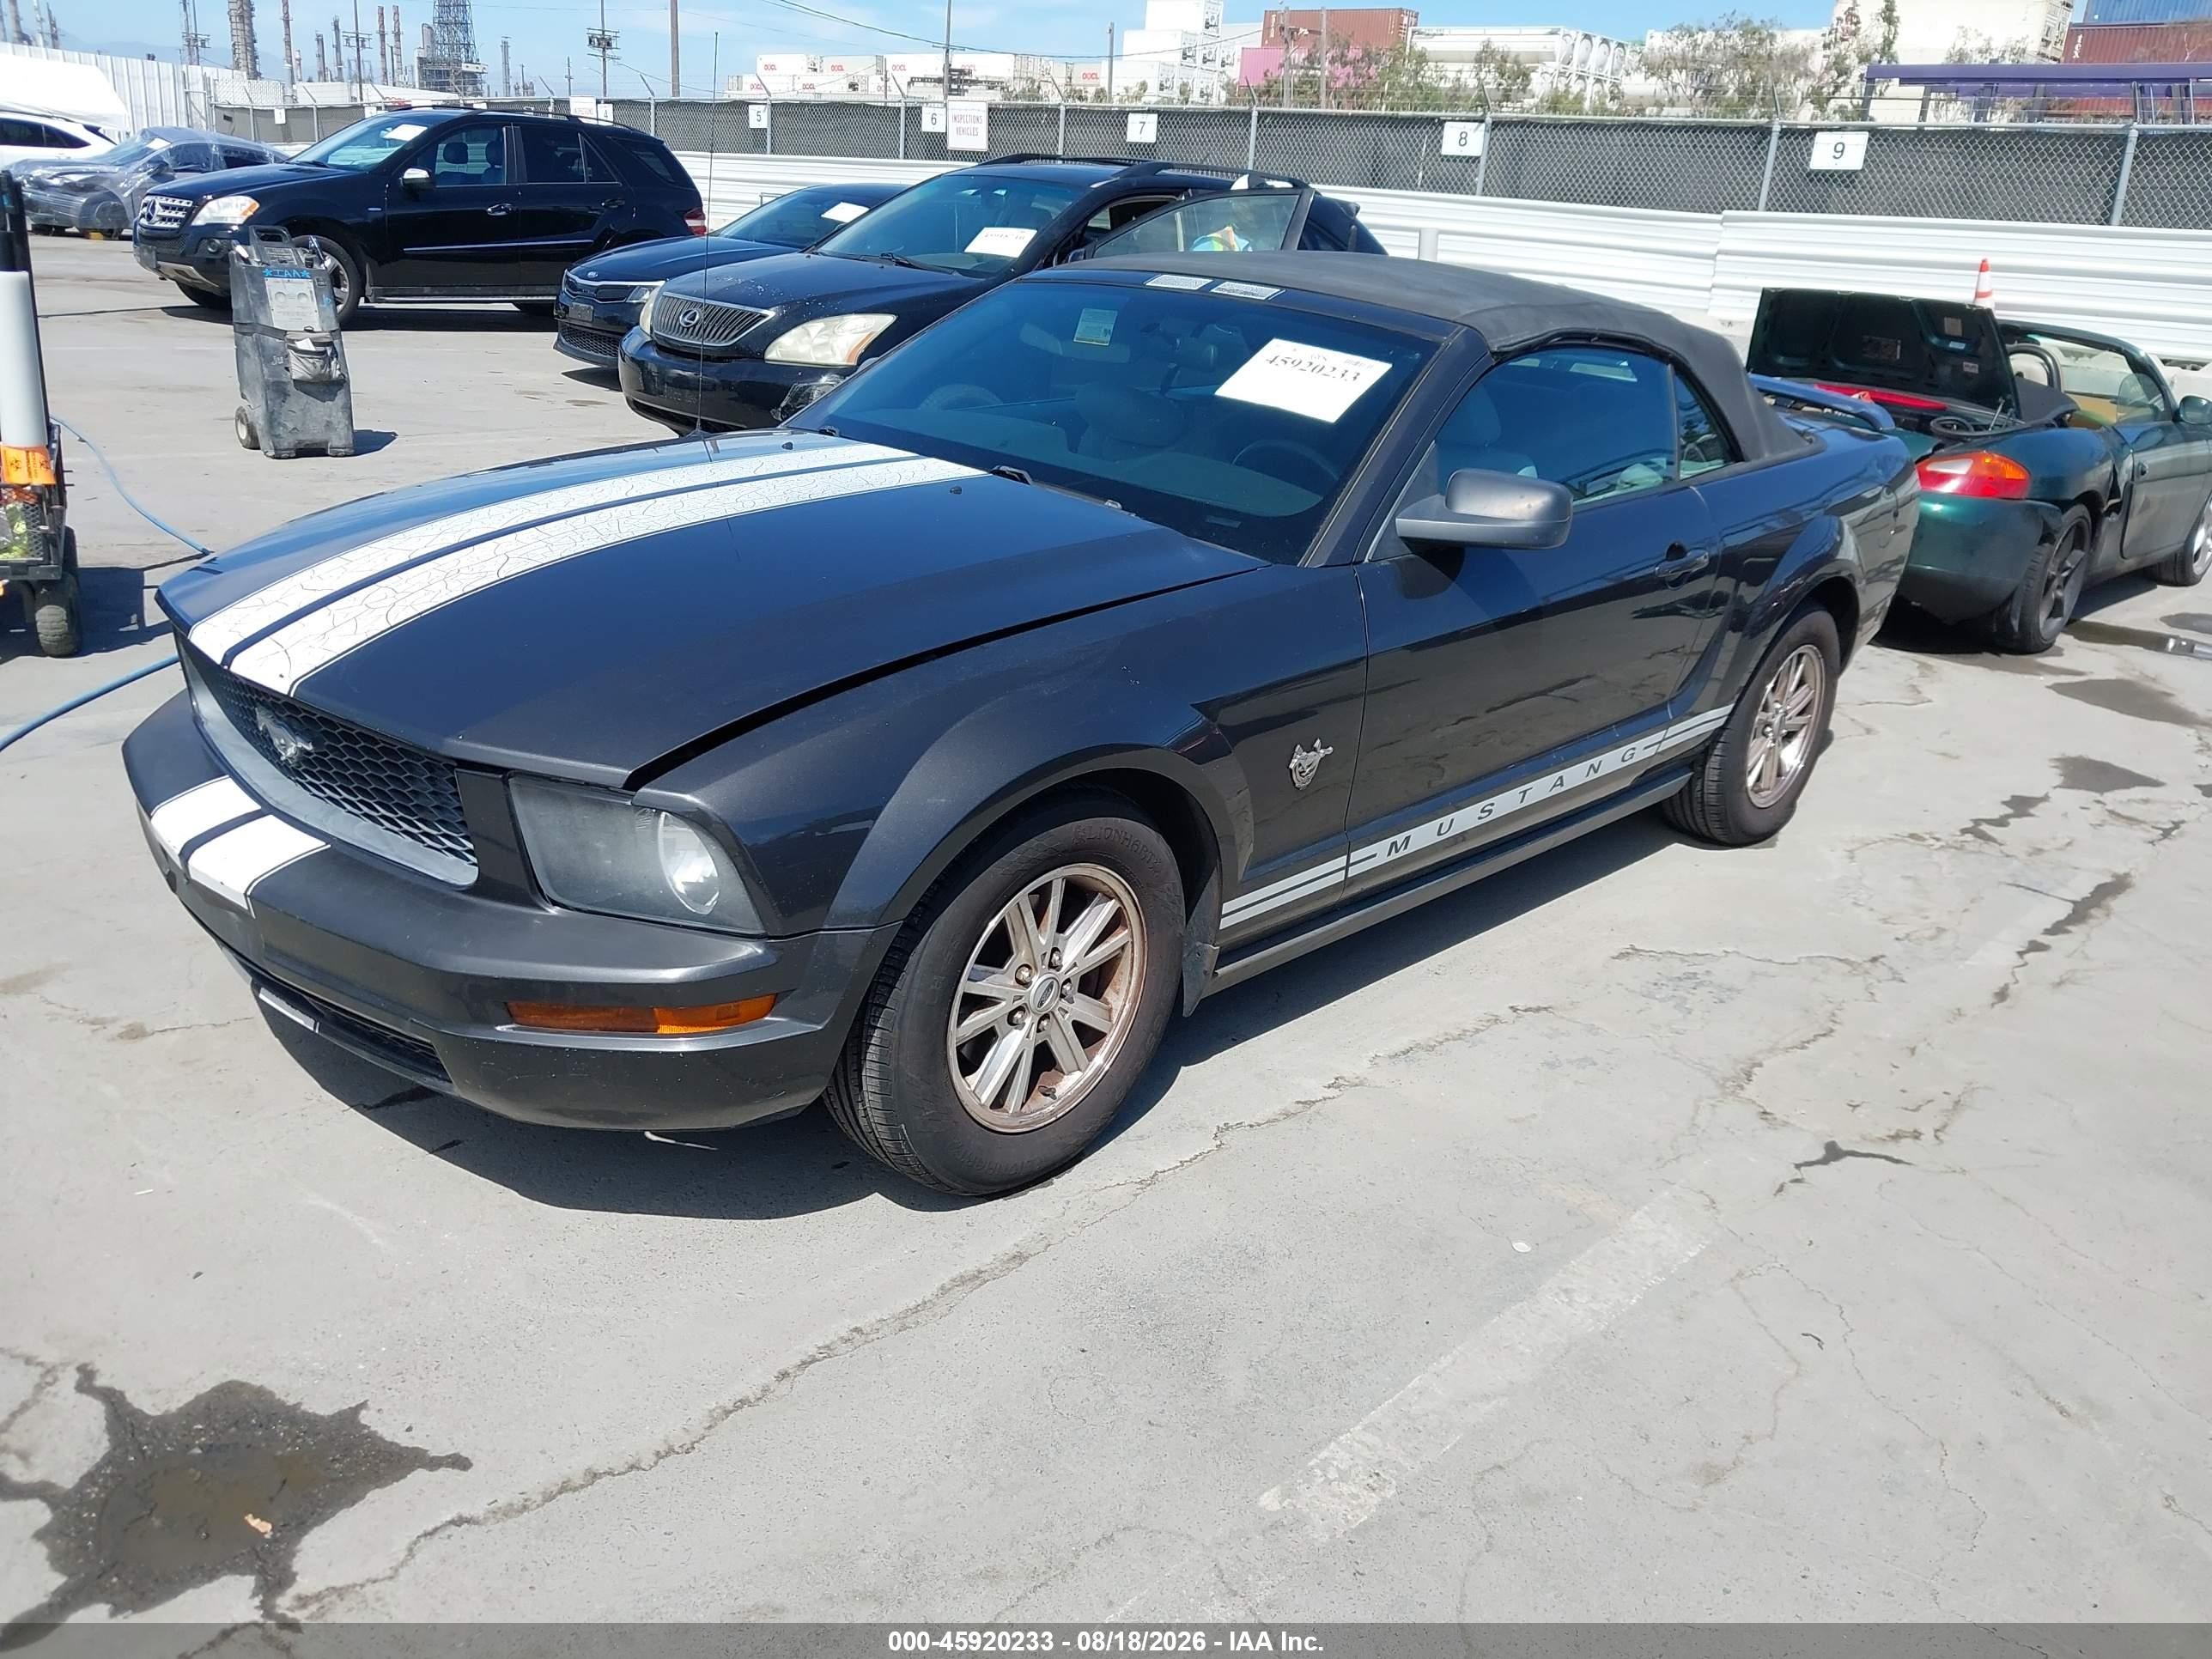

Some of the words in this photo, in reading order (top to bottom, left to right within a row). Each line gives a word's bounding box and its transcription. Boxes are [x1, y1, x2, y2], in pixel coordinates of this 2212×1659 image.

[757, 111, 763, 122] 5
[930, 112, 938, 125] 6
[951, 113, 983, 125] INSPECTIONS
[956, 126, 979, 137] VEHICLES
[1139, 121, 1146, 135] 7
[1458, 131, 1468, 147] 8
[1832, 141, 1845, 160] 9
[1266, 355, 1361, 381] 45920233
[1386, 745, 1637, 858] MUSTANG
